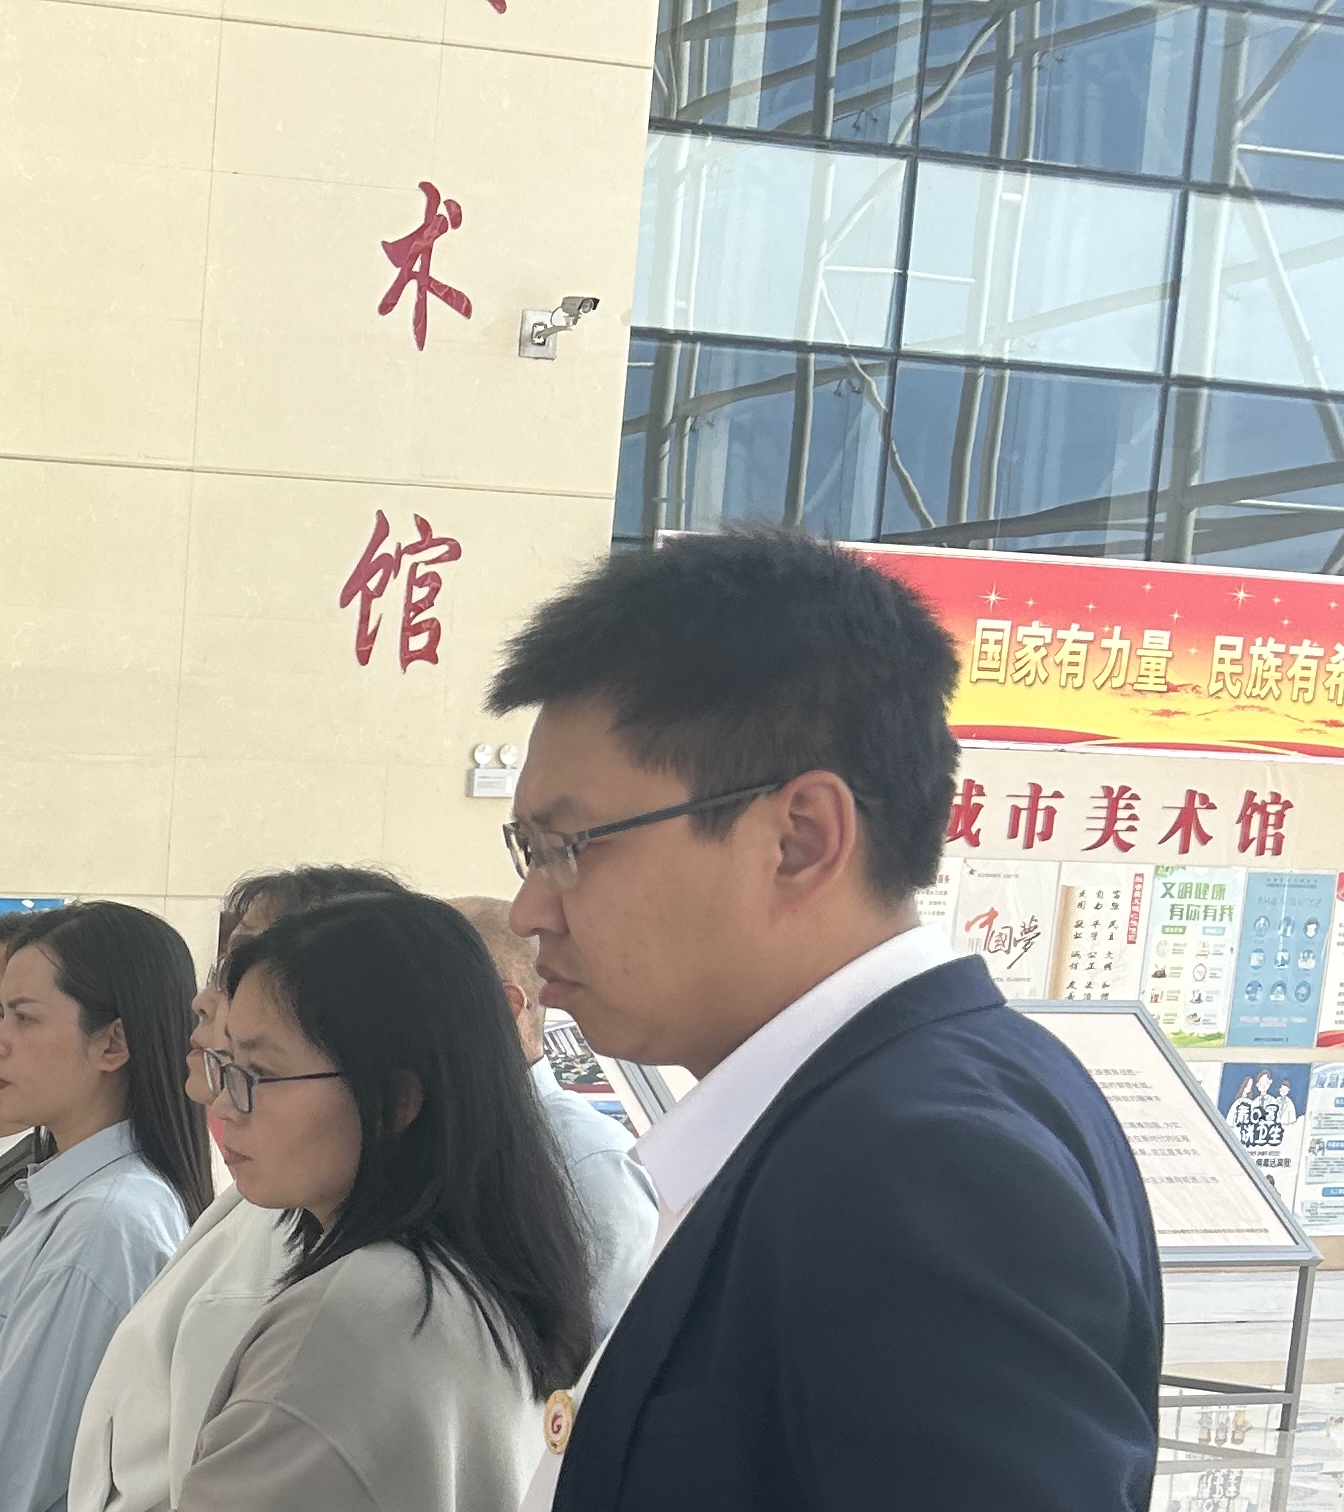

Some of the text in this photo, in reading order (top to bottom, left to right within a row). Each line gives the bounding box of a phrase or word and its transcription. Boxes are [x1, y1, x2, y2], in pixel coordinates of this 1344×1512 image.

[969, 618, 1175, 694] 国家有力量
[1160, 882, 1227, 900] 文明健康
[1169, 904, 1234, 922] 有你有我
[1240, 1123, 1284, 1148] 讲卫生
